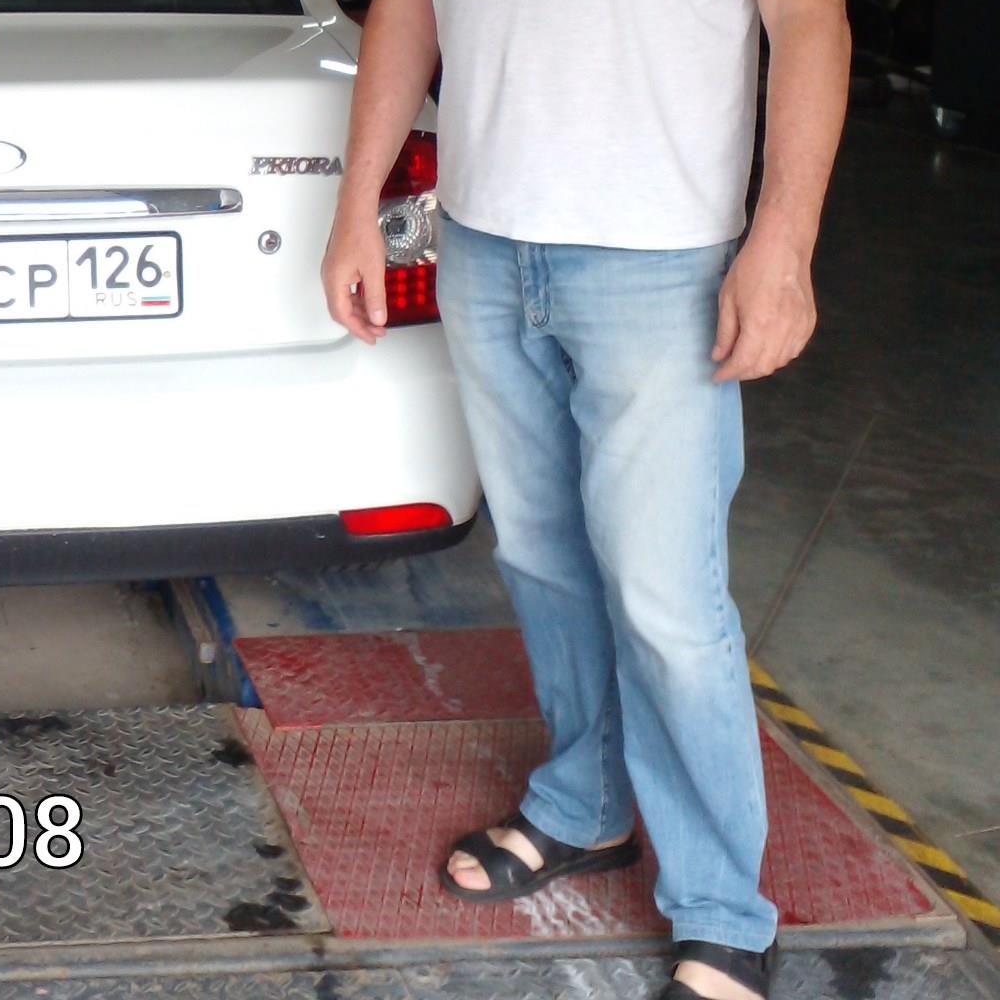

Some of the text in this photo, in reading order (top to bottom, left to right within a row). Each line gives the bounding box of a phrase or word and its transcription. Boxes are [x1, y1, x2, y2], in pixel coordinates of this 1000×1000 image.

[250, 156, 344, 175] PRIORA
[75, 244, 163, 290] 126
[95, 292, 137, 307] RUS
